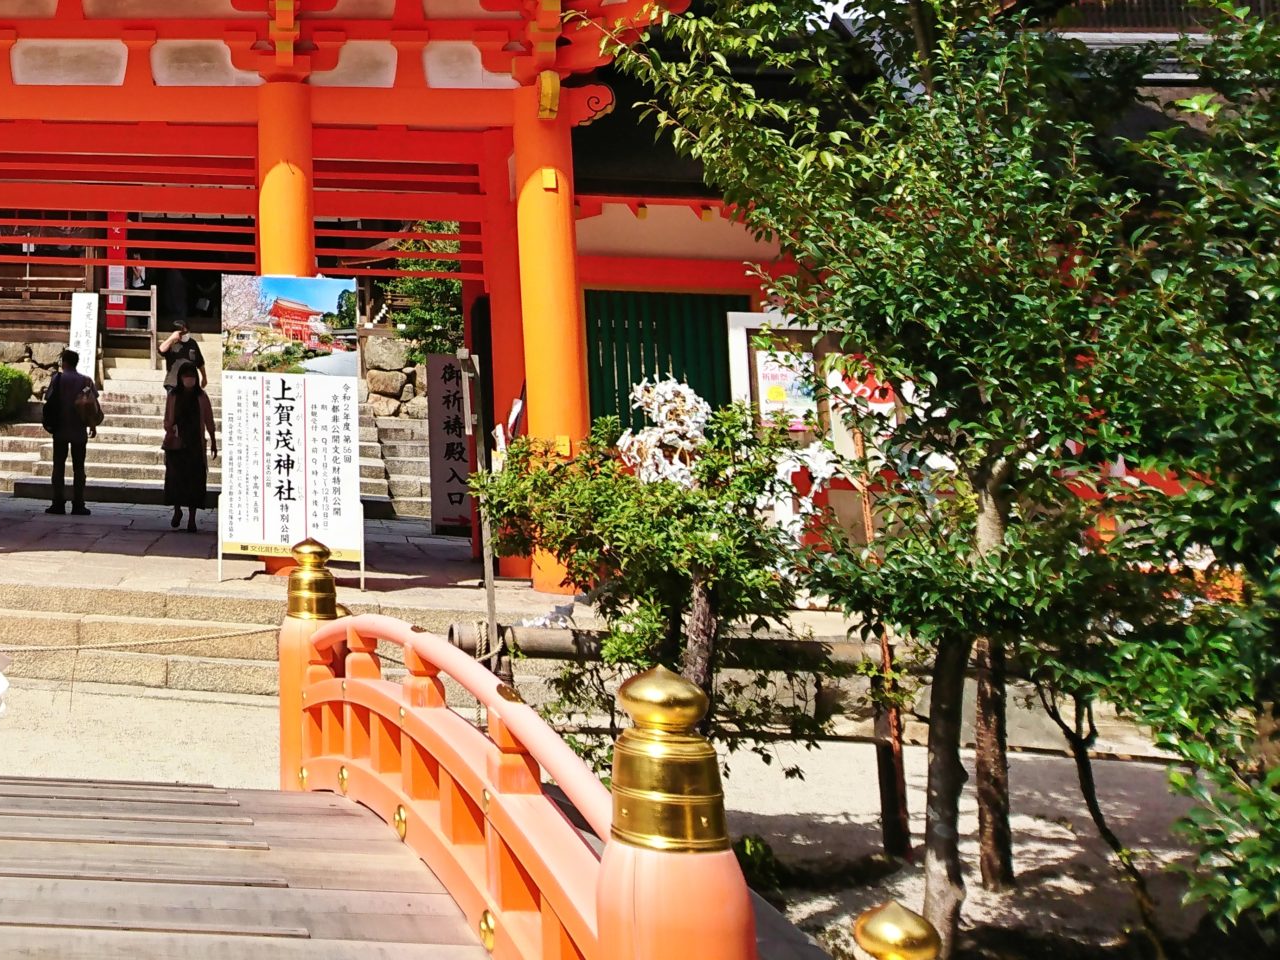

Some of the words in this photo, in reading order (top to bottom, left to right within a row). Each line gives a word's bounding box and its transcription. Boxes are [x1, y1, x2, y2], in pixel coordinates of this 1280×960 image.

[342, 383, 351, 431] 令和2年度
[273, 377, 297, 502] 上賀茂神社
[331, 393, 342, 517] 京都非公開文化財特別公開
[343, 435, 352, 464] 第56回
[280, 503, 290, 544] 特別公開
